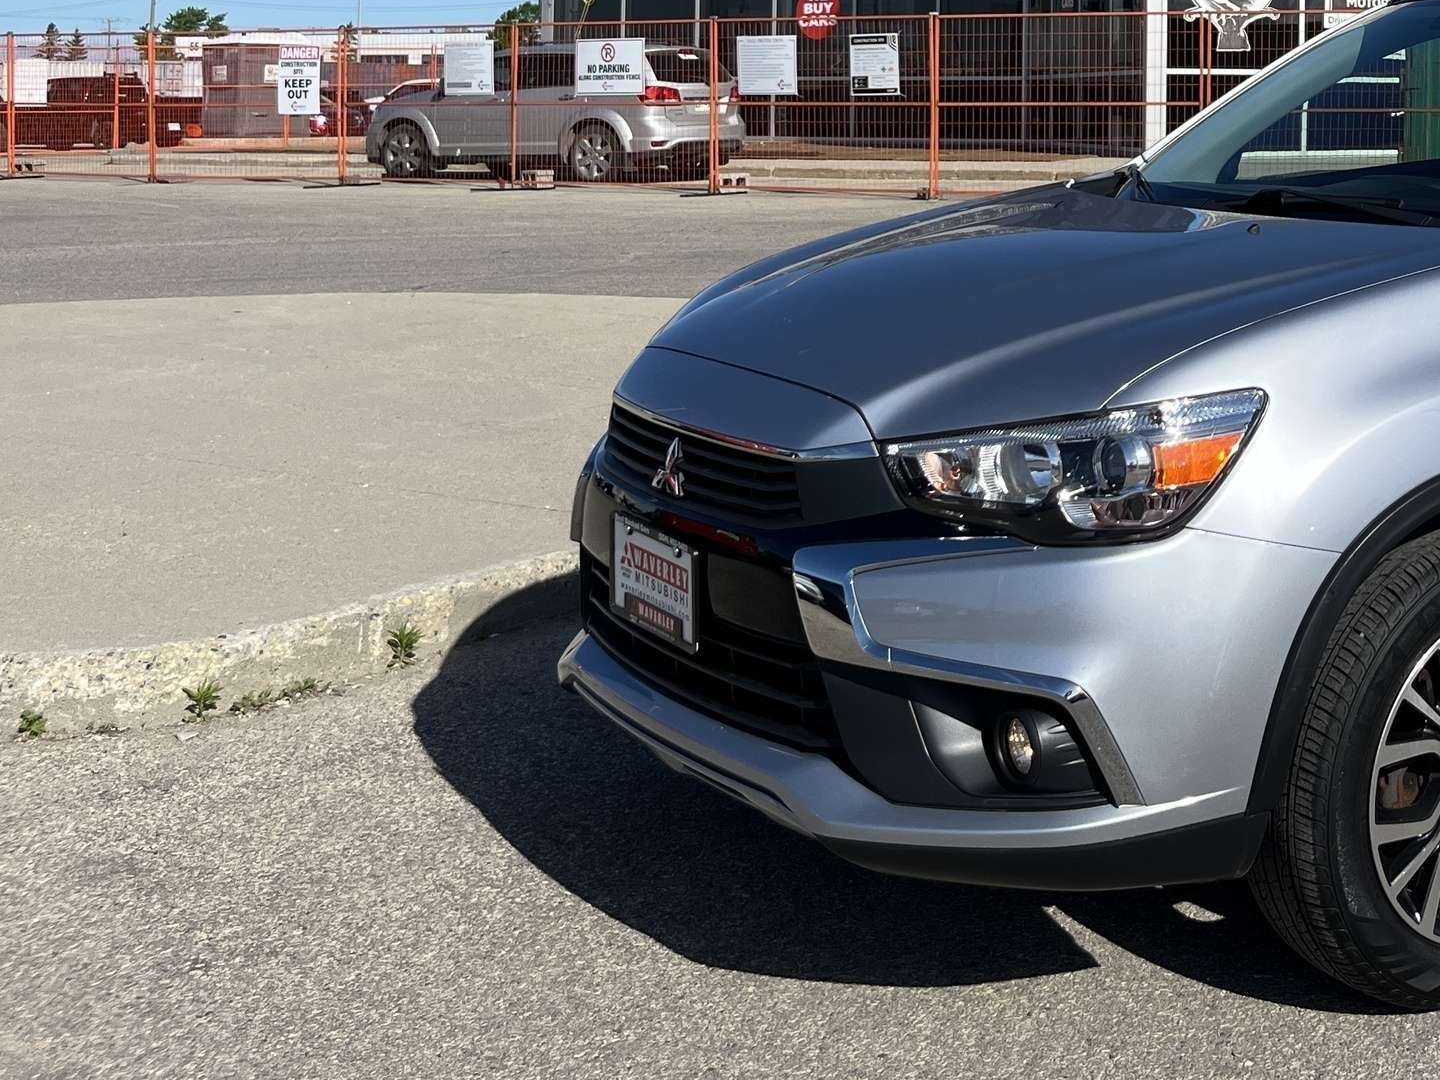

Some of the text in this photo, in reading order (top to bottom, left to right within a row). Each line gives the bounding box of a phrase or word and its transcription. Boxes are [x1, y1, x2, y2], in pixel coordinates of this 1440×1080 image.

[803, 2, 834, 14] BUY
[799, 15, 837, 27] CARS
[281, 47, 319, 59] DANGER
[587, 64, 630, 73] NO PARKING
[284, 79, 312, 89] KEEP
[287, 89, 309, 99] OUT
[633, 546, 688, 590] WAVERLEY
[635, 570, 688, 608] MITSUBISHI
[638, 602, 675, 633] WAVERLEY
